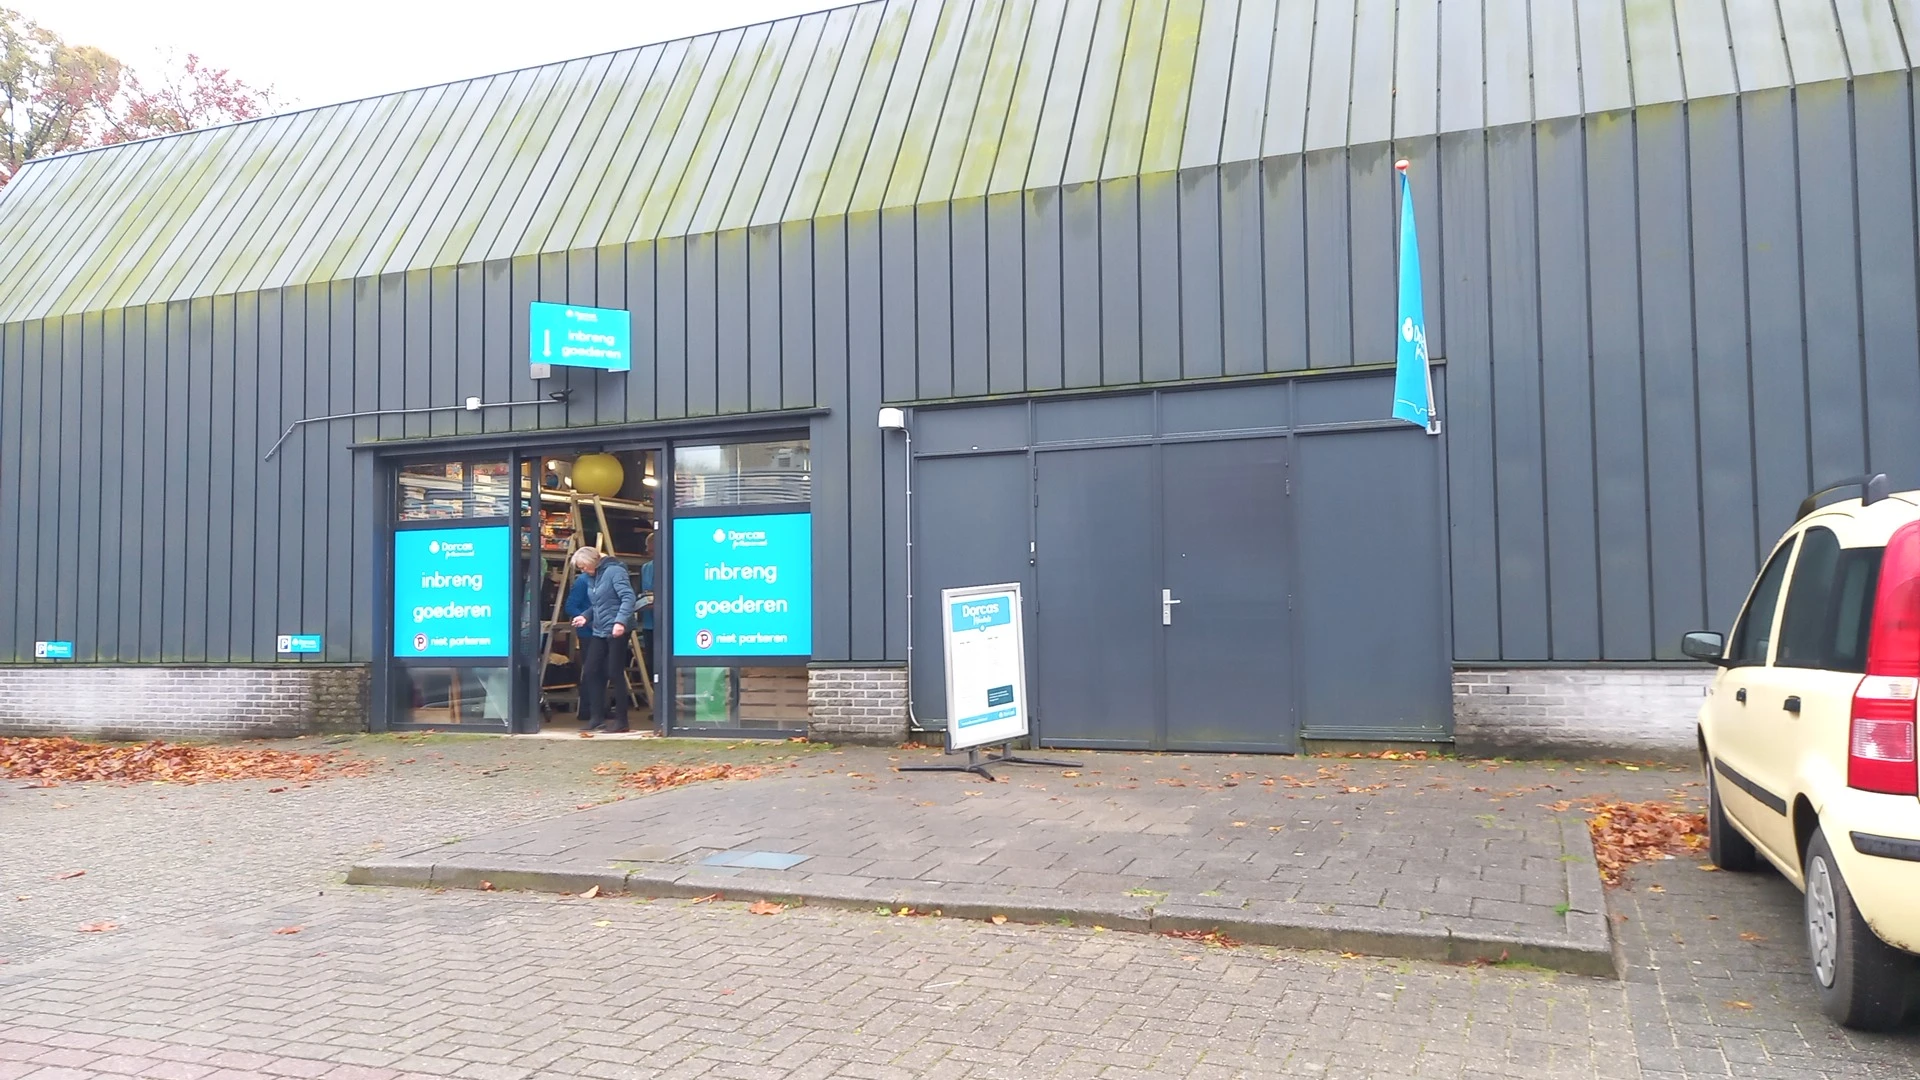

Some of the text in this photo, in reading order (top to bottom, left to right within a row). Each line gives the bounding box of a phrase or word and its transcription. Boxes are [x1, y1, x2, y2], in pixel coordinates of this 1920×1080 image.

[568, 330, 615, 347] inbreng
[562, 346, 621, 359] goederen
[728, 530, 766, 540] Dorcas
[442, 542, 474, 551] Dorcas
[704, 562, 777, 584] inbreng
[421, 571, 483, 591] inbreng
[413, 601, 491, 623] goederen
[695, 595, 788, 619] goederen
[962, 603, 1000, 618] Dorcas
[430, 636, 448, 646] niet
[449, 635, 491, 648] parkeren
[716, 633, 737, 643] niet
[739, 632, 788, 646] parkeren
